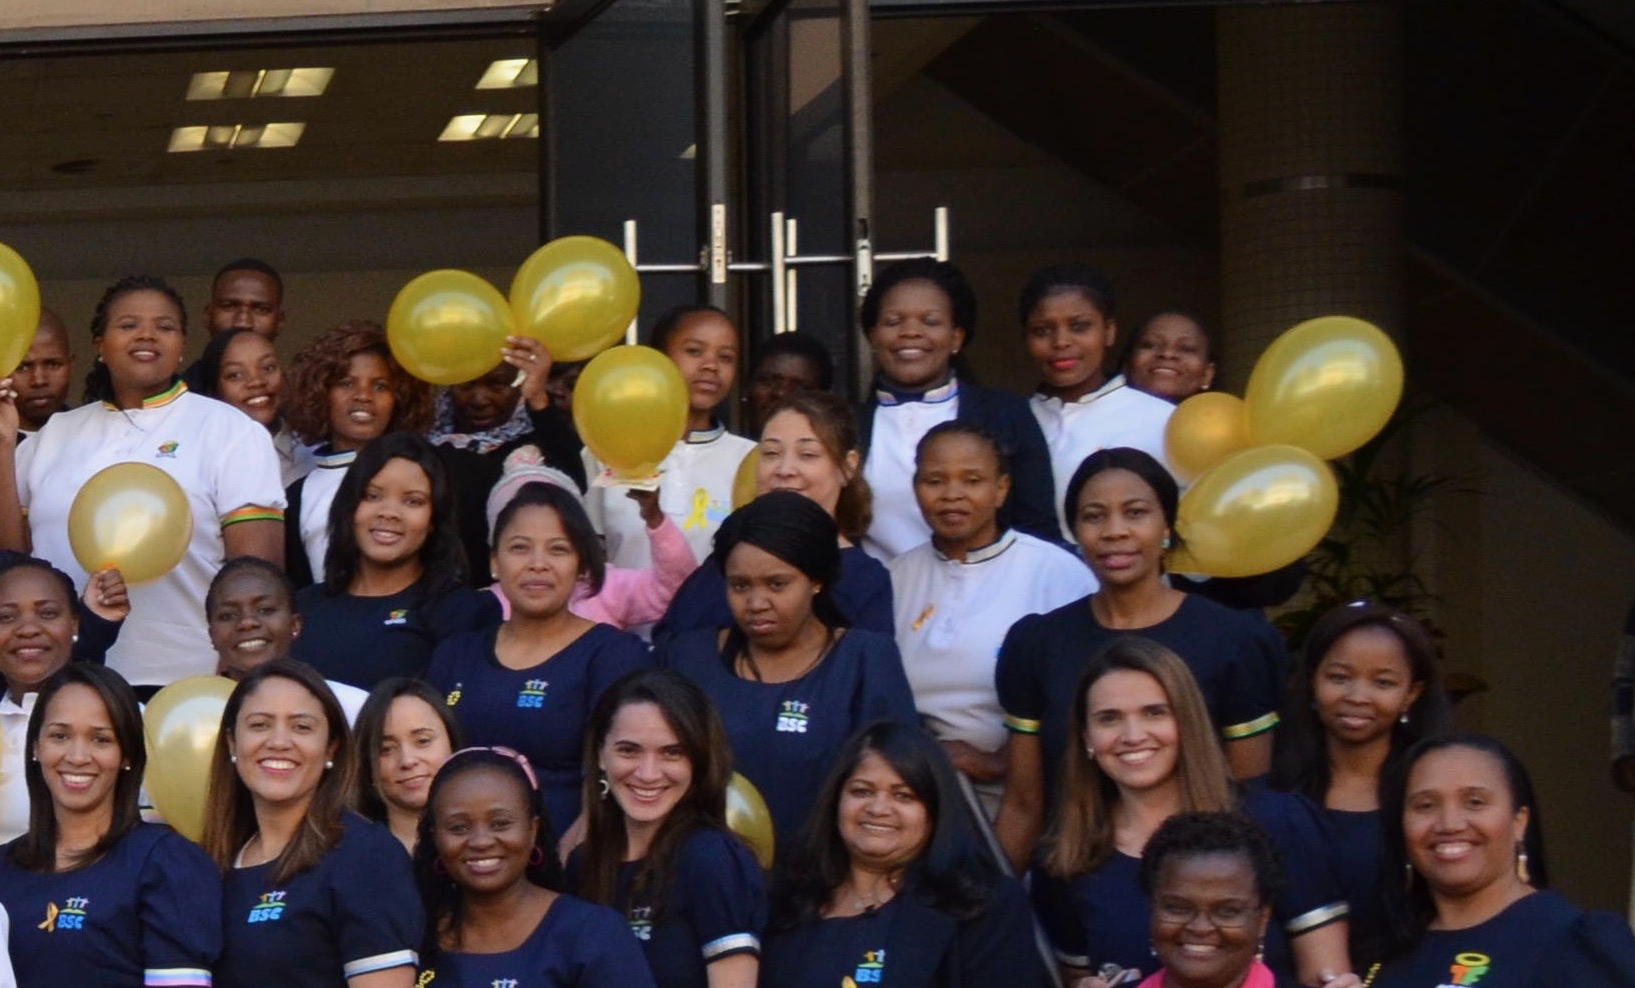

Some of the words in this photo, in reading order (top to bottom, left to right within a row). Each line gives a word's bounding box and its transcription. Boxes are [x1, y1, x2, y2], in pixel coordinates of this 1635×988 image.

[517, 695, 545, 708] BSC
[776, 716, 808, 733] BSC
[57, 914, 85, 929] BSC
[247, 907, 284, 923] BSC
[855, 968, 882, 983] BS
